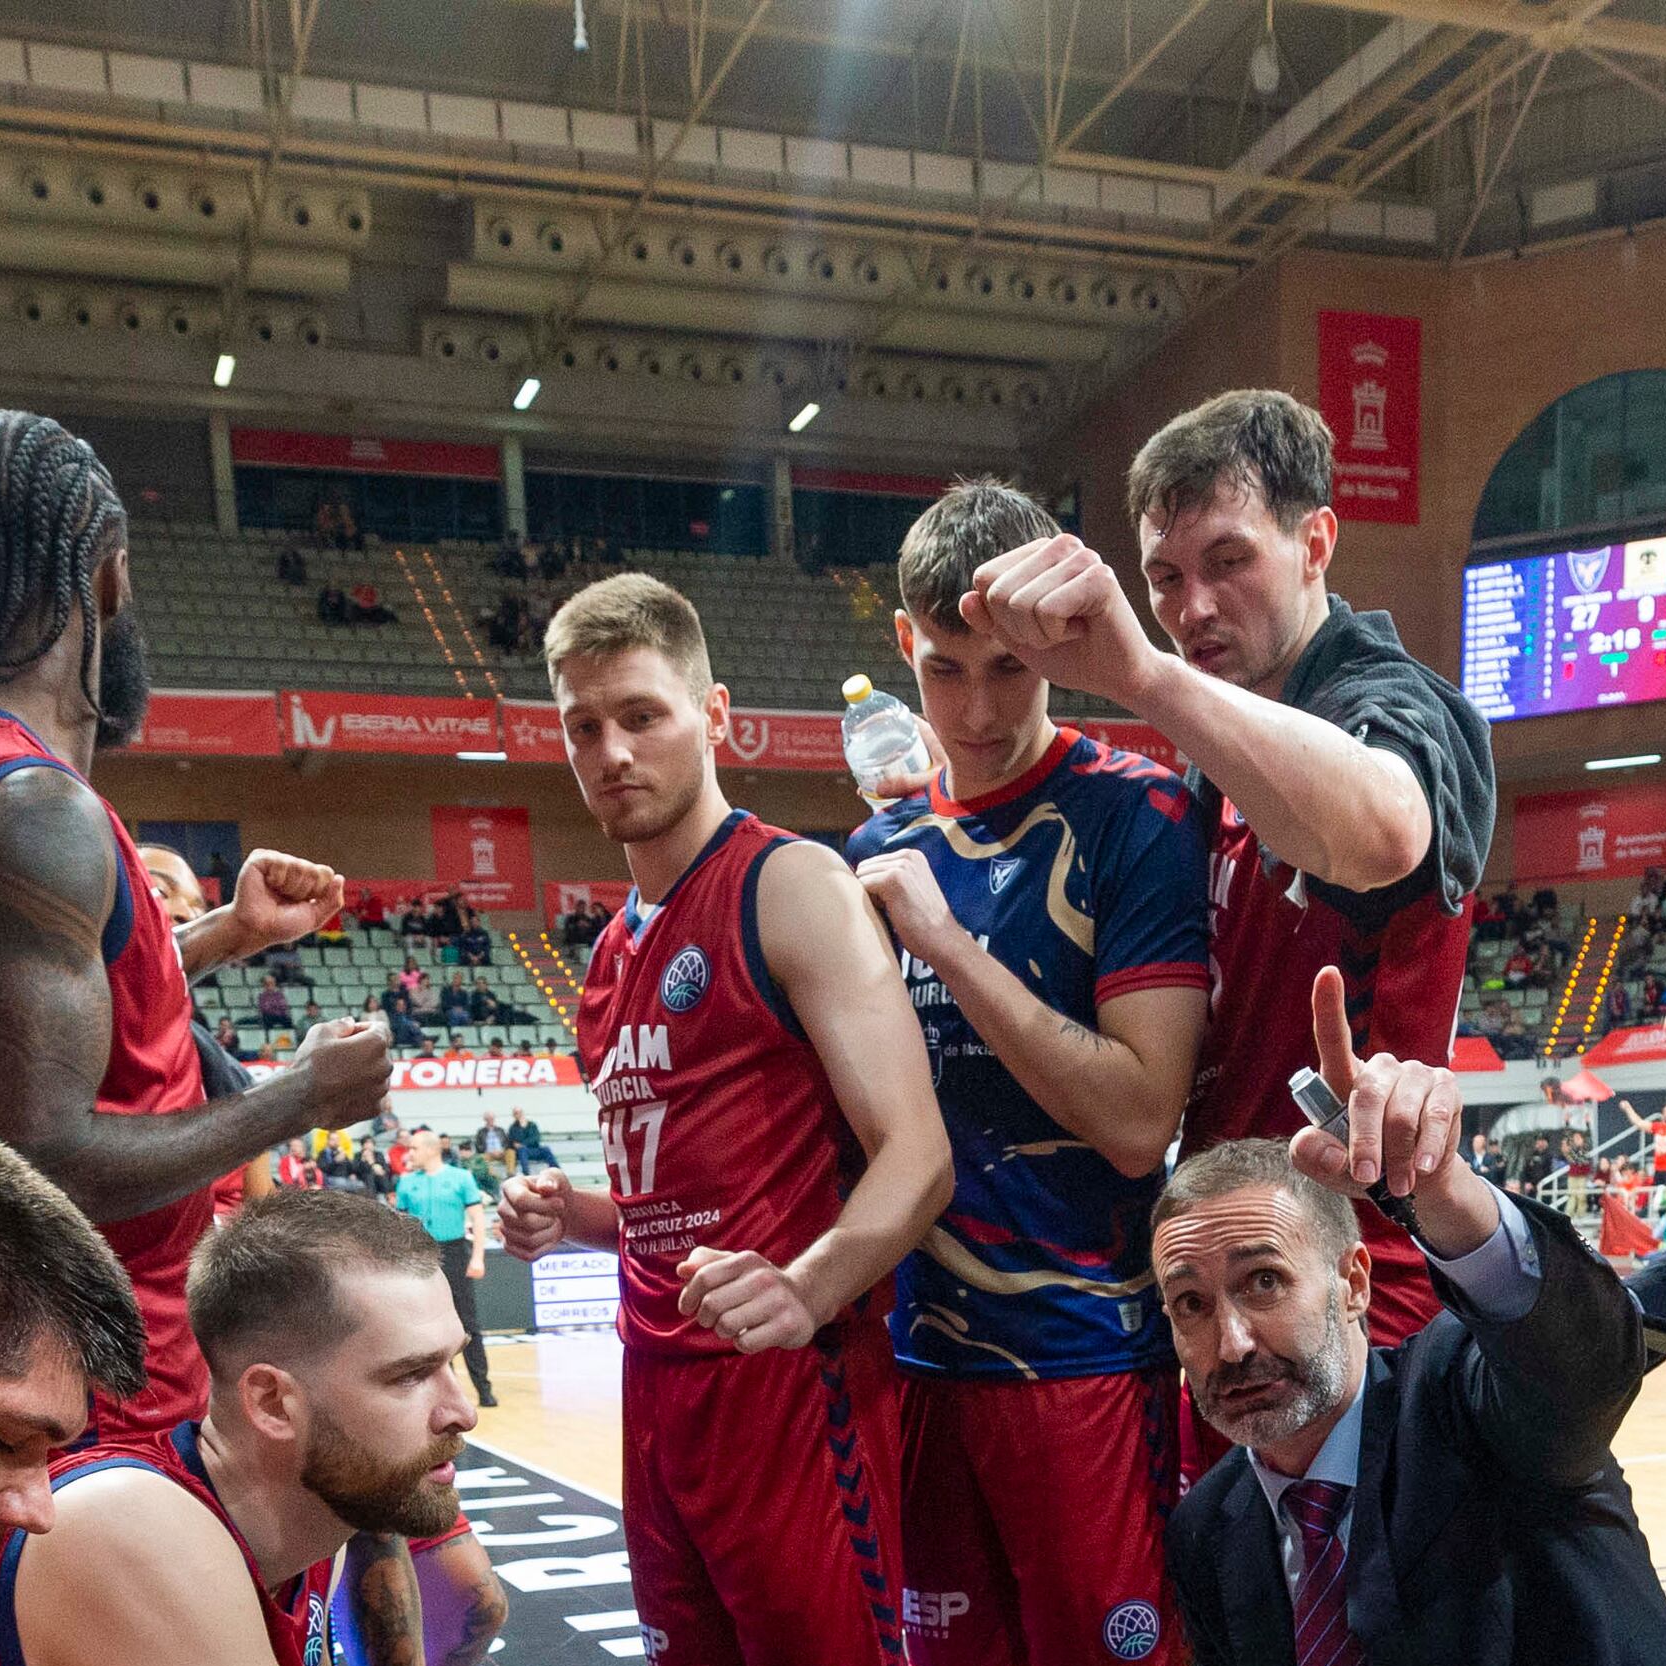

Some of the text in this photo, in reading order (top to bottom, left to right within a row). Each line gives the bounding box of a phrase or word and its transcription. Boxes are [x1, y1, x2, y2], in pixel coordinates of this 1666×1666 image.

[1571, 603, 1601, 632] 27
[651, 1216, 683, 1235] CRUZ
[685, 1208, 722, 1228] 2024
[539, 1258, 610, 1271] MERCADO
[541, 1306, 611, 1320] CORREOS
[902, 1587, 970, 1628] ESP
